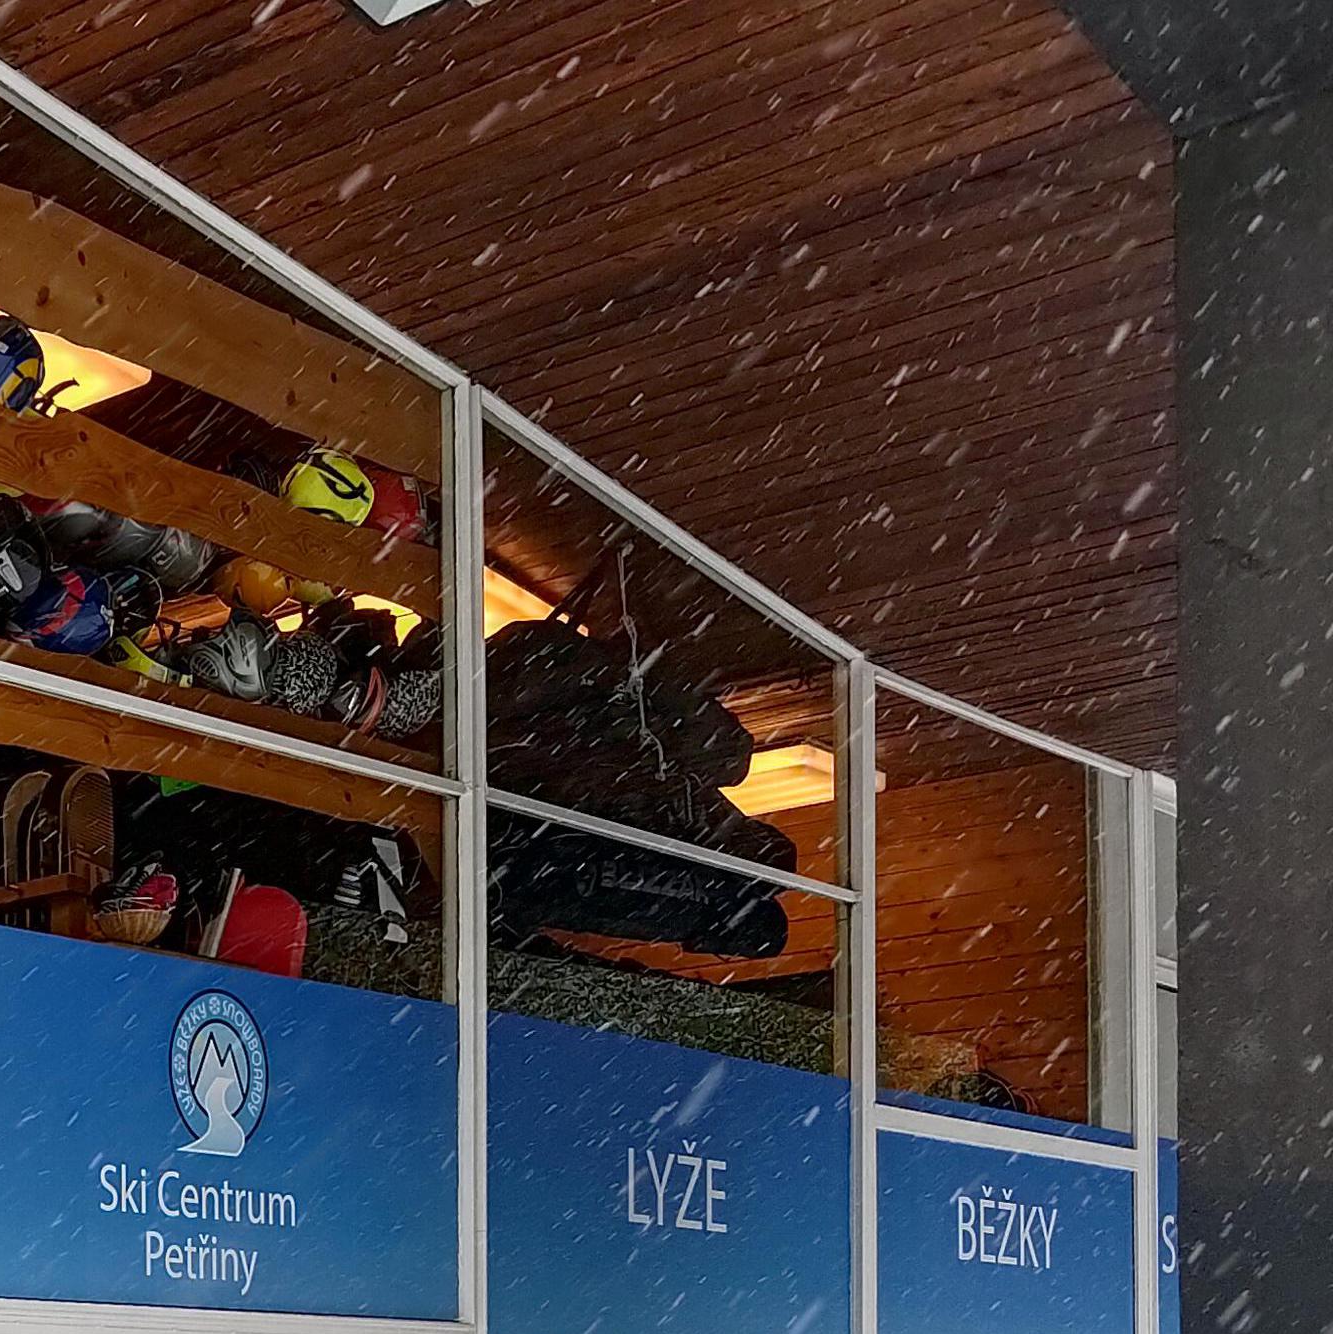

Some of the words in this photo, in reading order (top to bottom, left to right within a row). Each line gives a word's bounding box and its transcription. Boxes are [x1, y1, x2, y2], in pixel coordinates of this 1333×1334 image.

[176, 1001, 207, 1051] BĚŽKY
[222, 999, 264, 1117] SNOWBOARDY
[99, 1164, 147, 1214] Ski
[157, 1171, 296, 1227] Centrum
[627, 1140, 727, 1234] LYŽE
[145, 1230, 258, 1296] Petřiny
[957, 1185, 1058, 1269] BĚŽKY
